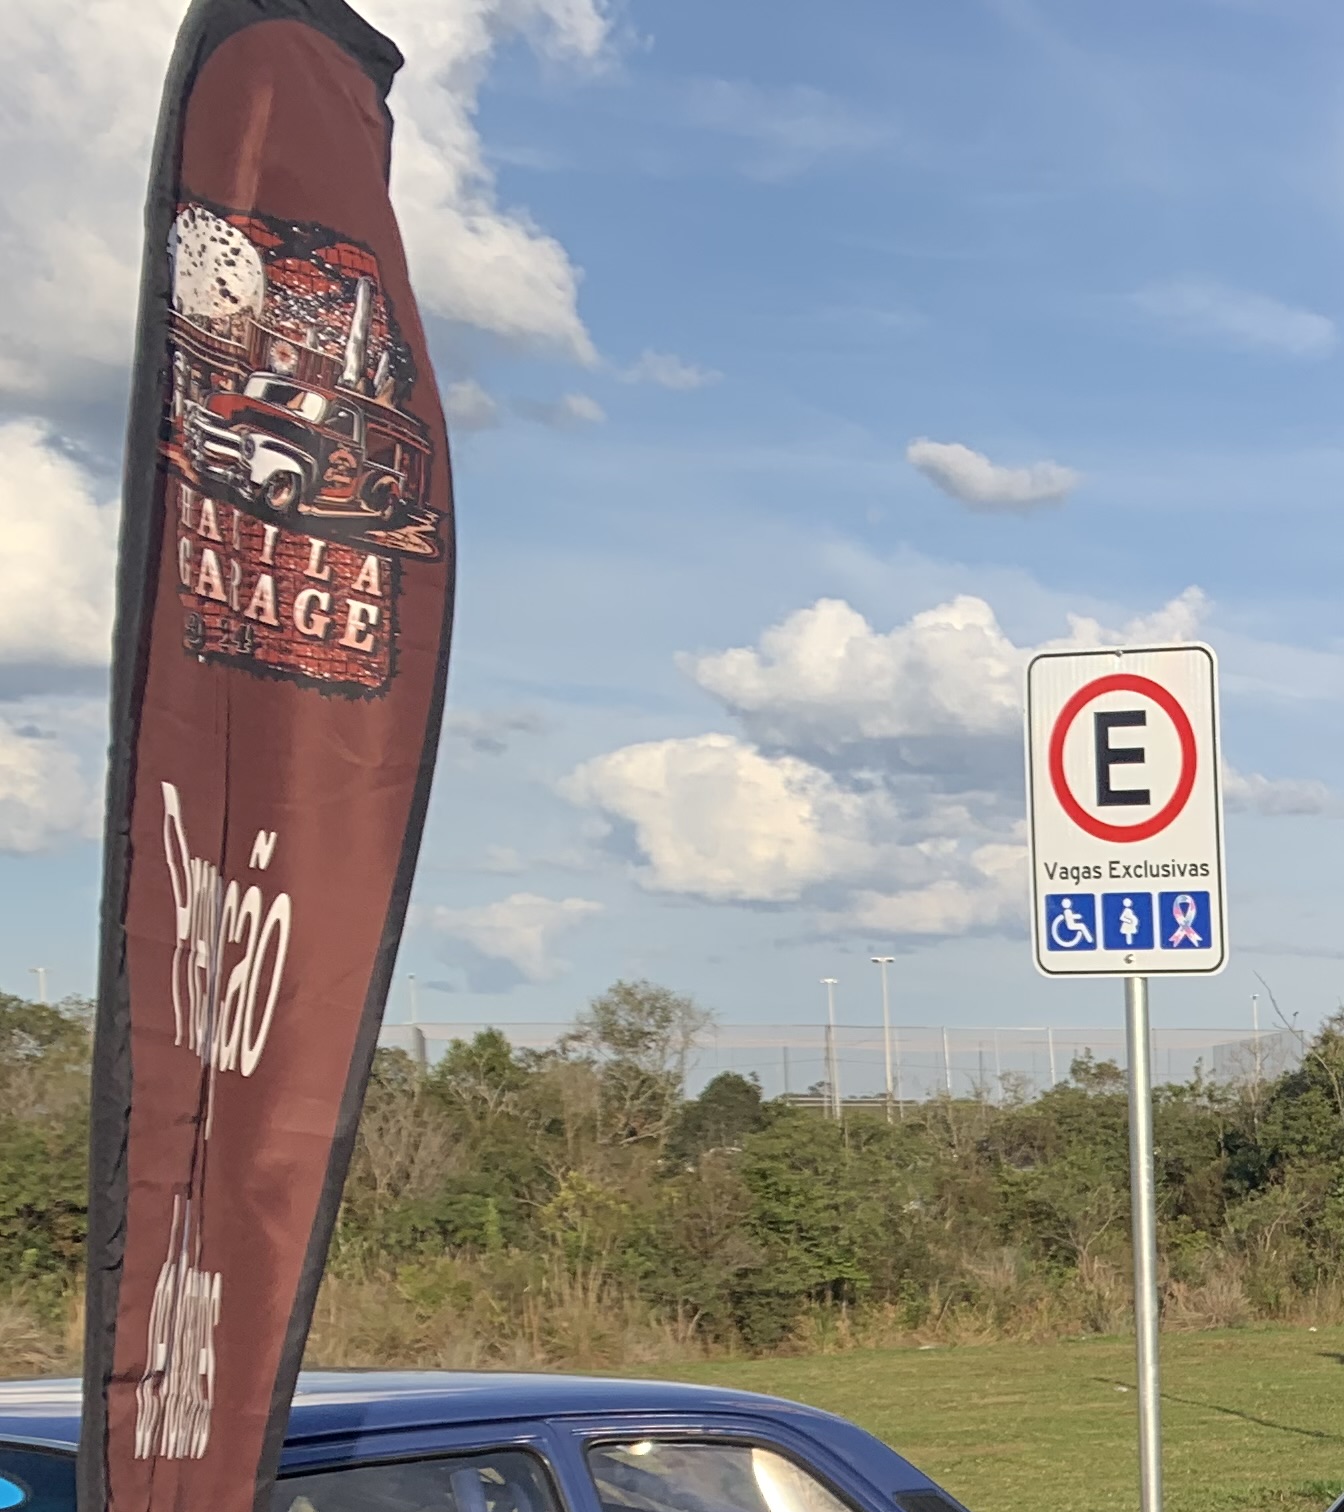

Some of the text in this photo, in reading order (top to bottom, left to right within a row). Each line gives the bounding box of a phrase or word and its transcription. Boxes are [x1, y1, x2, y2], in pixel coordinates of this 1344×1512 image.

[178, 536, 380, 653] GARAGE
[1093, 710, 1151, 807] E
[1044, 859, 1210, 886] Vagas Exclusivas
